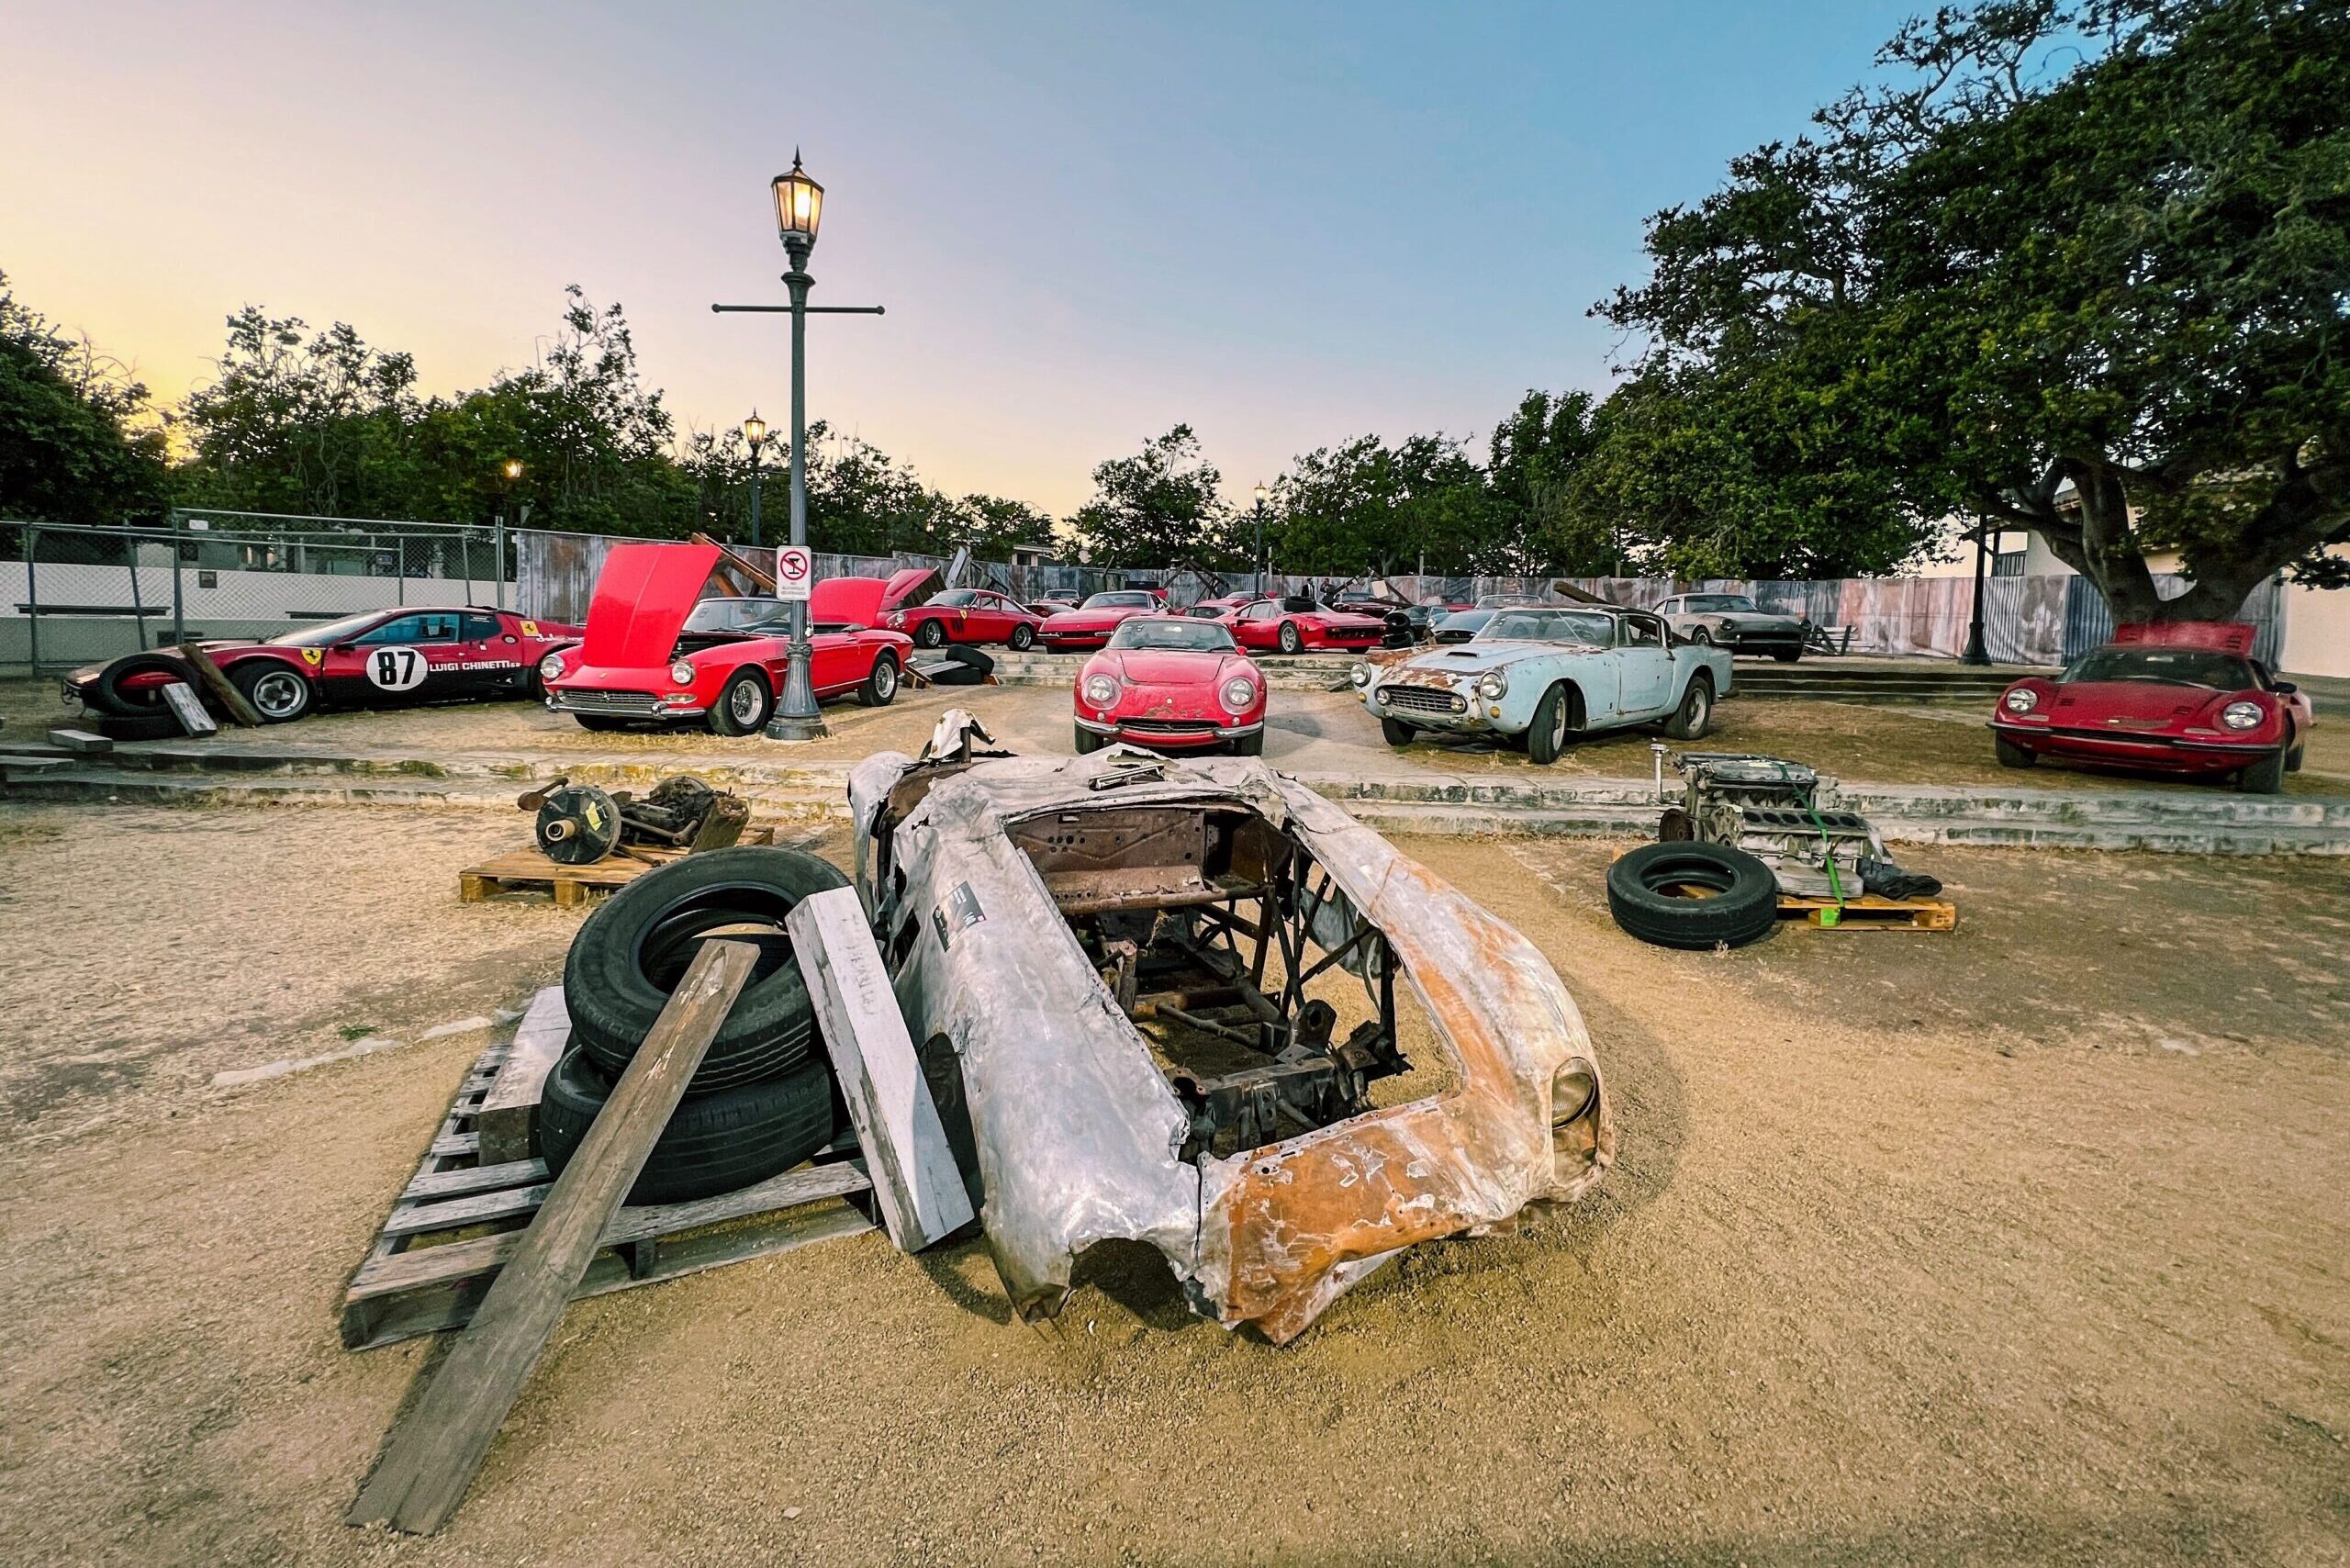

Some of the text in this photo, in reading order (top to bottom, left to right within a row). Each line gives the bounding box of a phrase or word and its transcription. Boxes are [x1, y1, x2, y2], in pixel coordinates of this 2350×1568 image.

[377, 651, 416, 686] 87
[429, 663, 459, 672] LUIGI
[462, 660, 510, 670] CHINETTI
